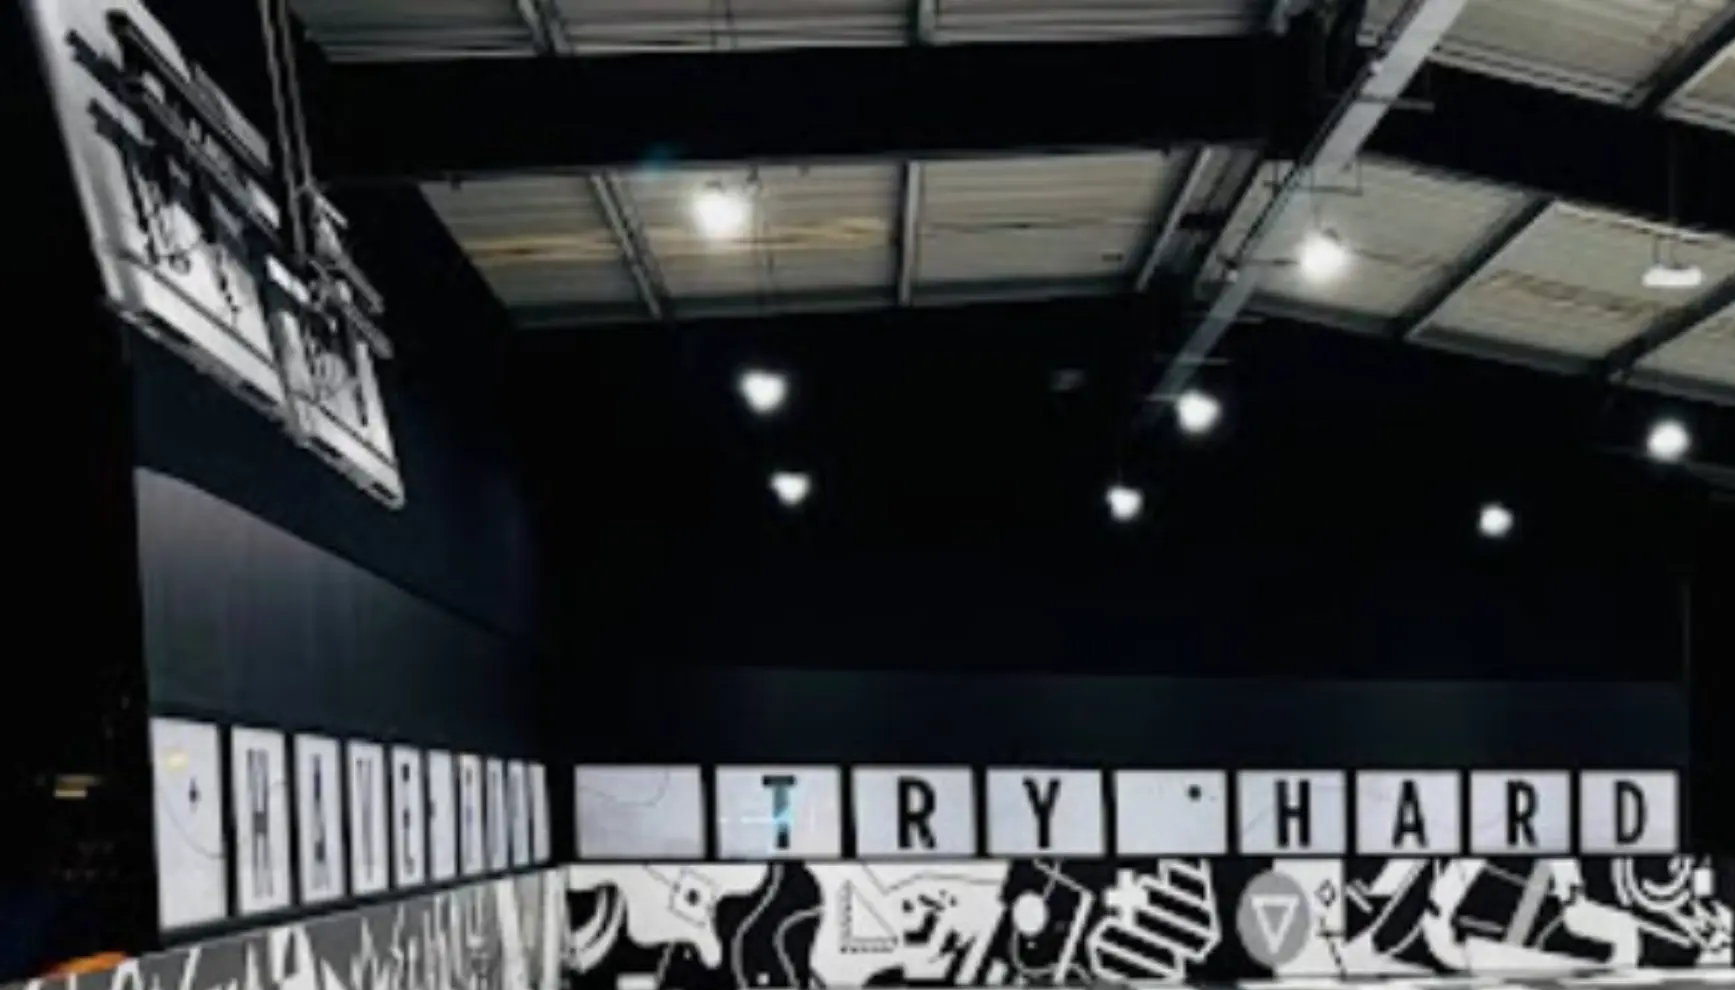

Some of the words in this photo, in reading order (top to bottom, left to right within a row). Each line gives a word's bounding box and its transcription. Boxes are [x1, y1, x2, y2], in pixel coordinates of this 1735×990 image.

[247, 748, 416, 899] HAVE
[762, 774, 1061, 850] TRY
[1275, 778, 1647, 849] HARD
